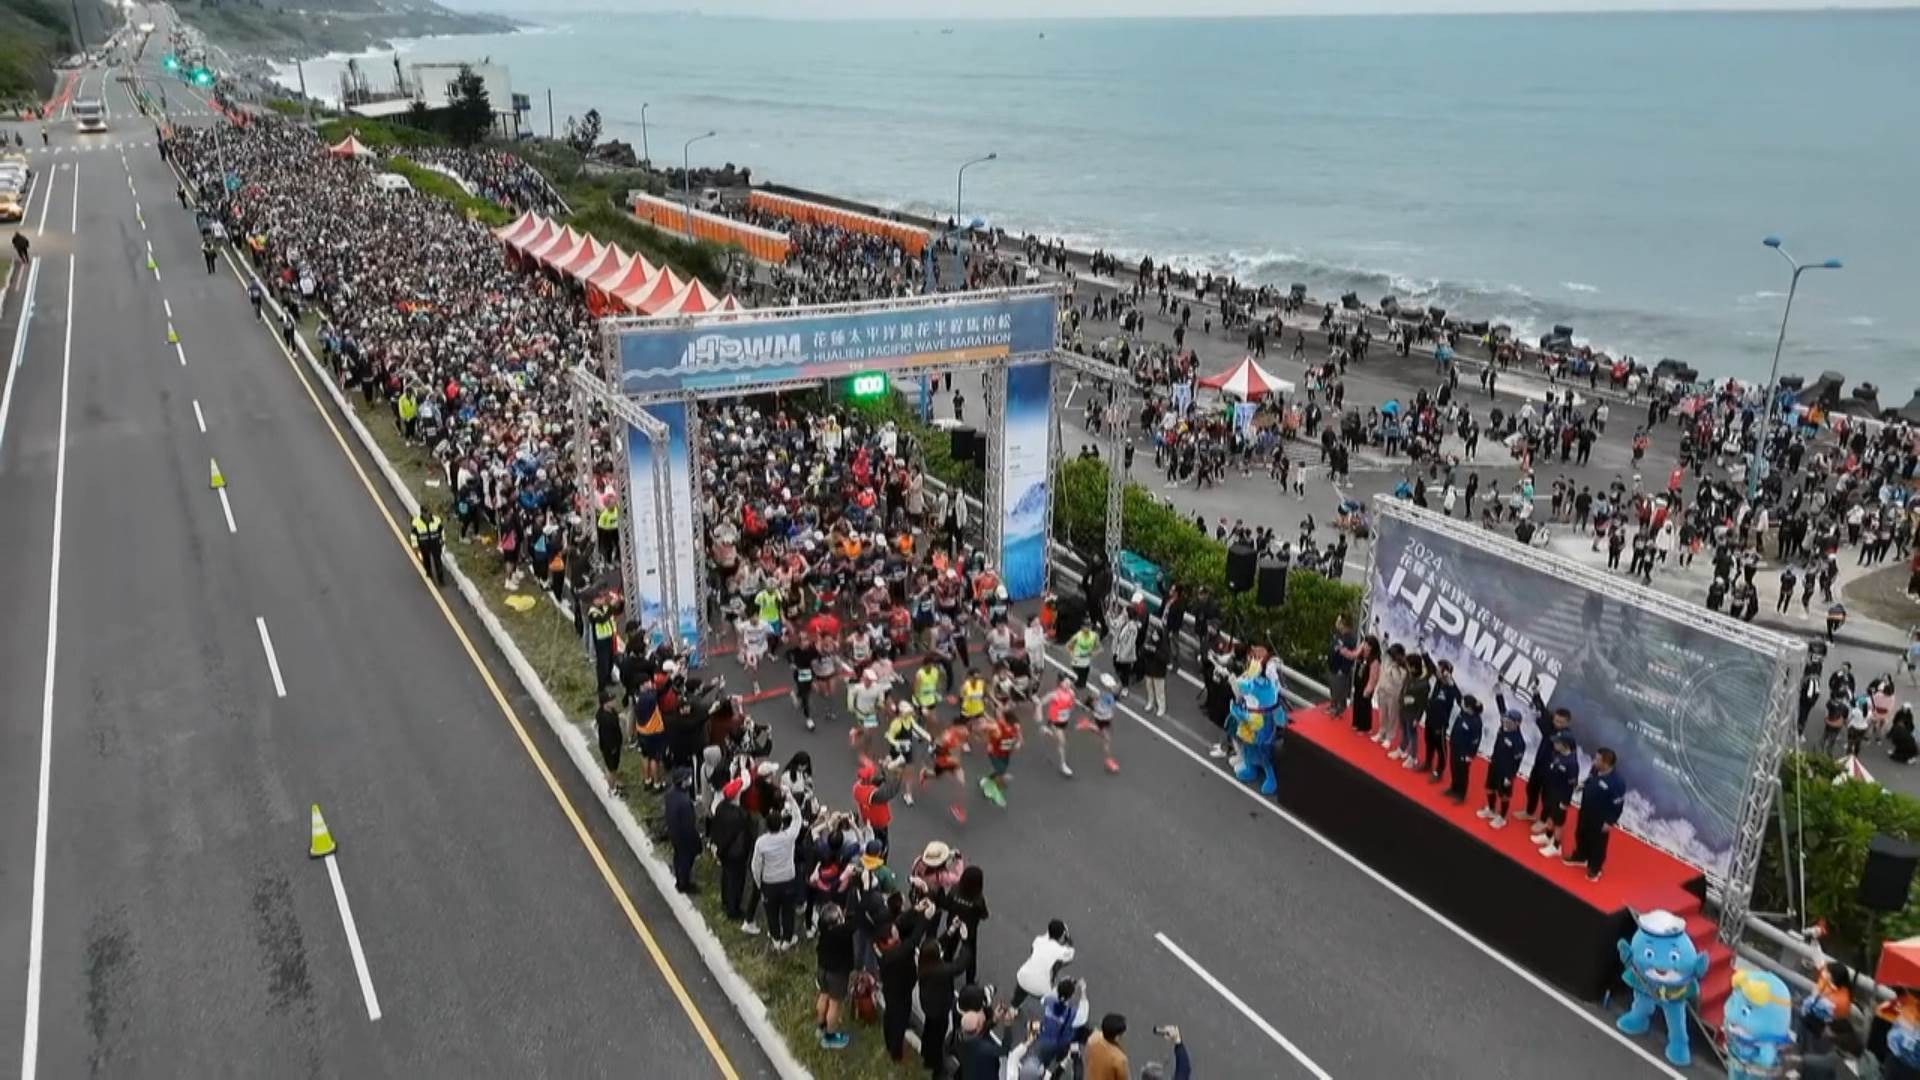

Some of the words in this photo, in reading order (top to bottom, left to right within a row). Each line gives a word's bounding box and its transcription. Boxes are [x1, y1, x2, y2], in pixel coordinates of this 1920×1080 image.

[813, 348, 864, 362] HUALIEN
[867, 342, 912, 358] PACIFIC
[914, 340, 946, 353] WAVE
[950, 333, 1012, 348] MARATHON
[1404, 537, 1443, 570] 2024
[1387, 566, 1558, 708] HPWM
